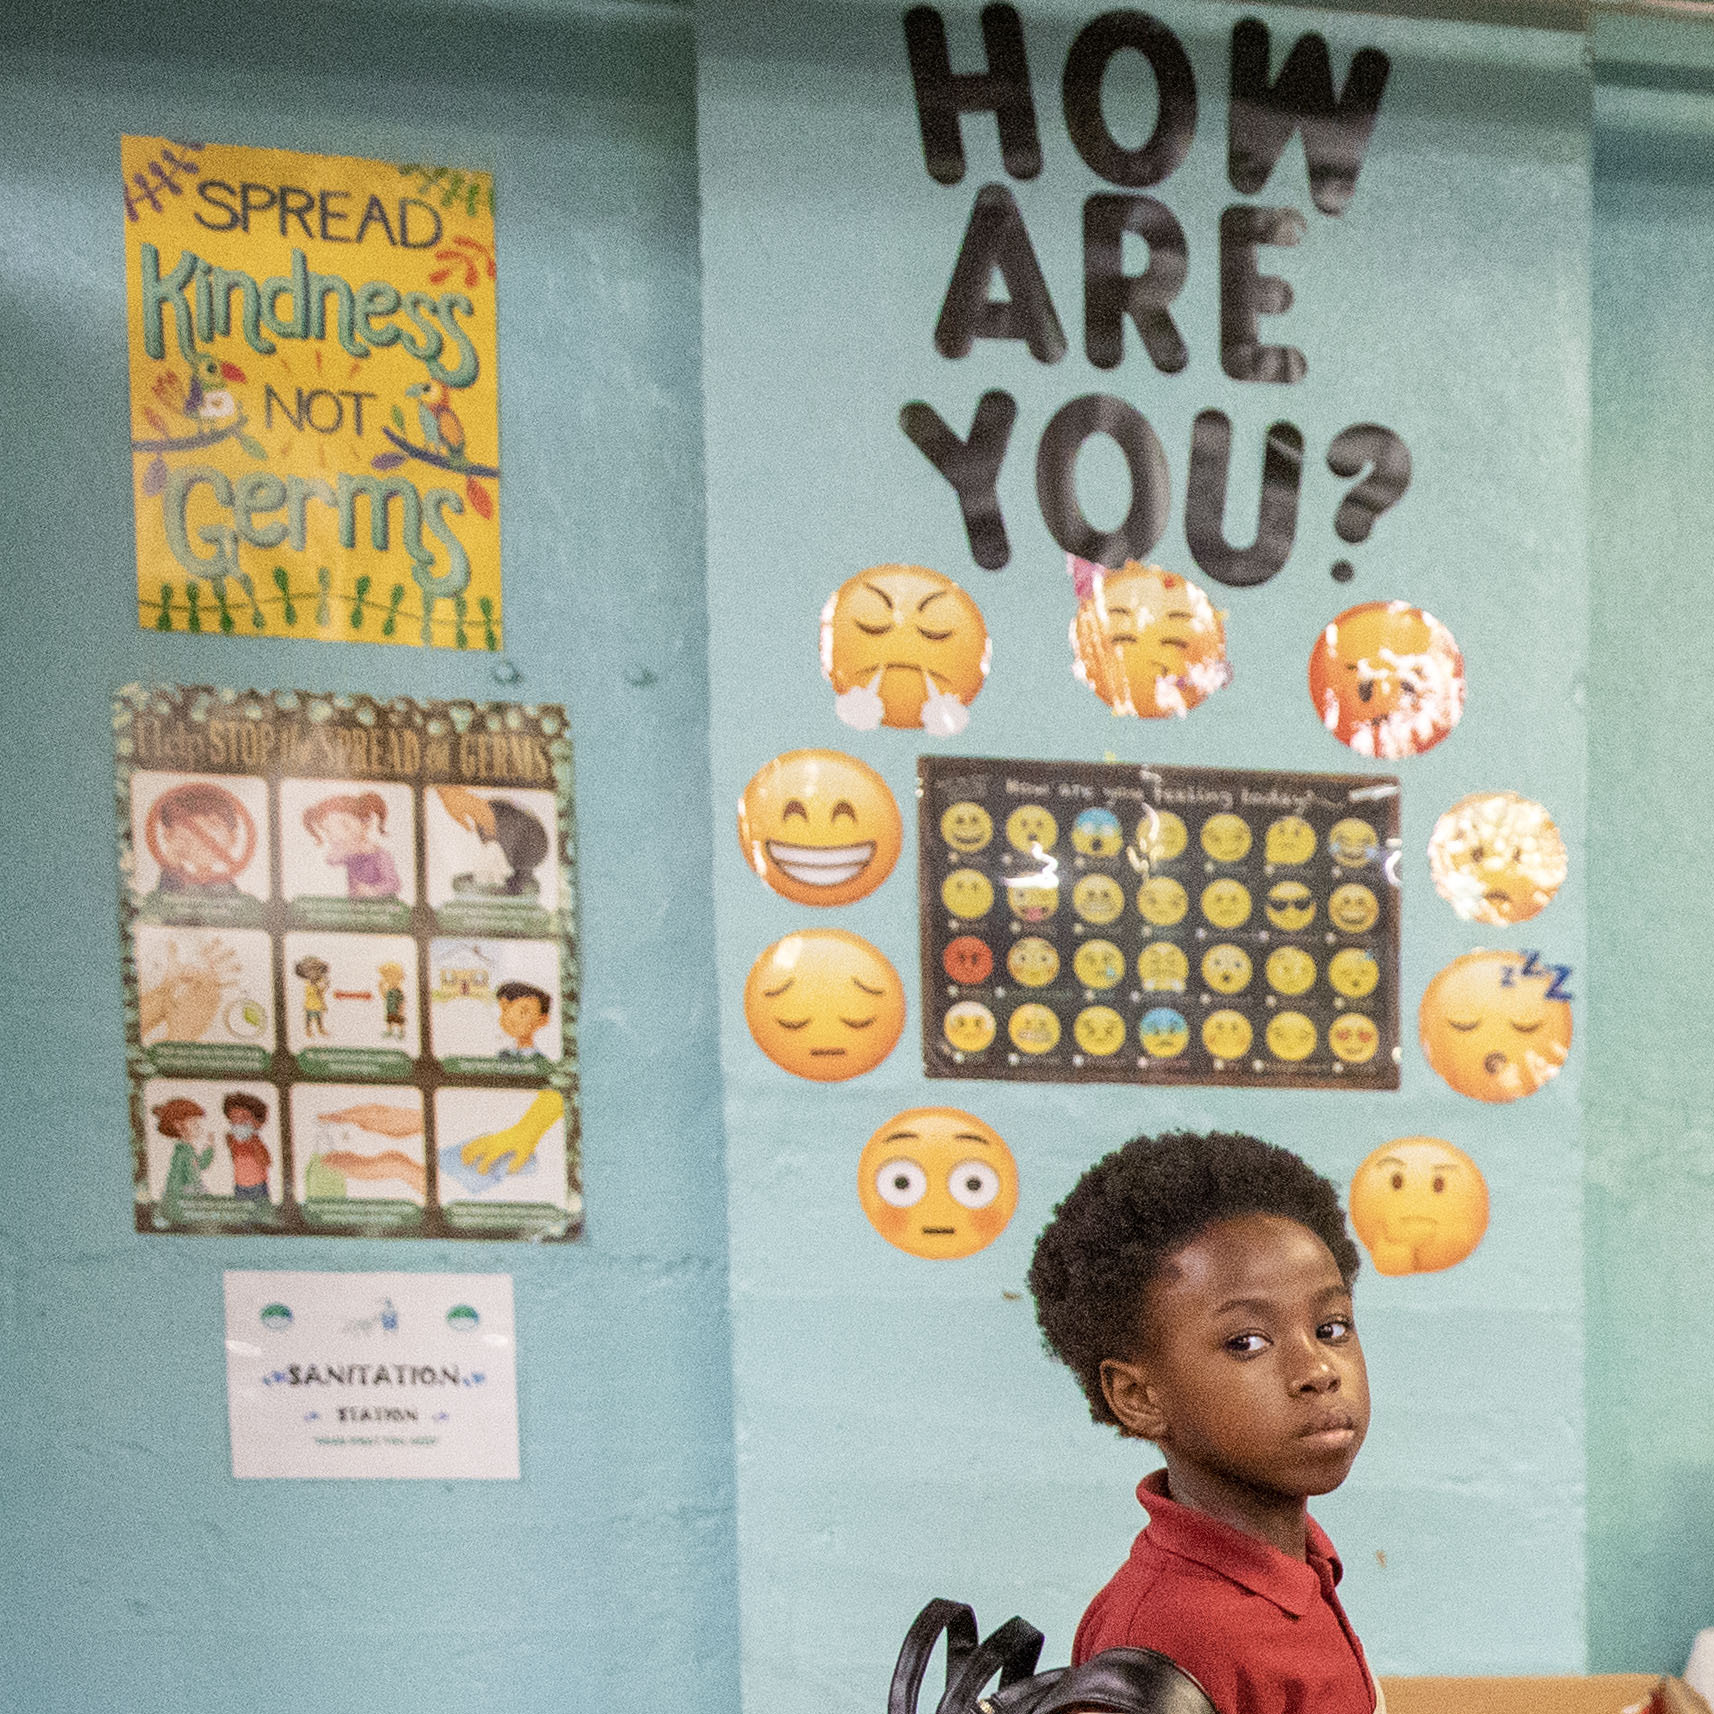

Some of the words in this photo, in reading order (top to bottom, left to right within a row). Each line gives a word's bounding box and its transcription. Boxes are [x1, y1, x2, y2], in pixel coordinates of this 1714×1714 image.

[903, 3, 1391, 217] HOW
[193, 178, 443, 250] SPREAD
[934, 183, 1307, 384] ARE
[141, 242, 481, 389] Kindness
[265, 384, 377, 436] NOT
[164, 464, 472, 598] Germs
[899, 388, 1412, 587] YOU?
[288, 1363, 460, 1387] SANITATION
